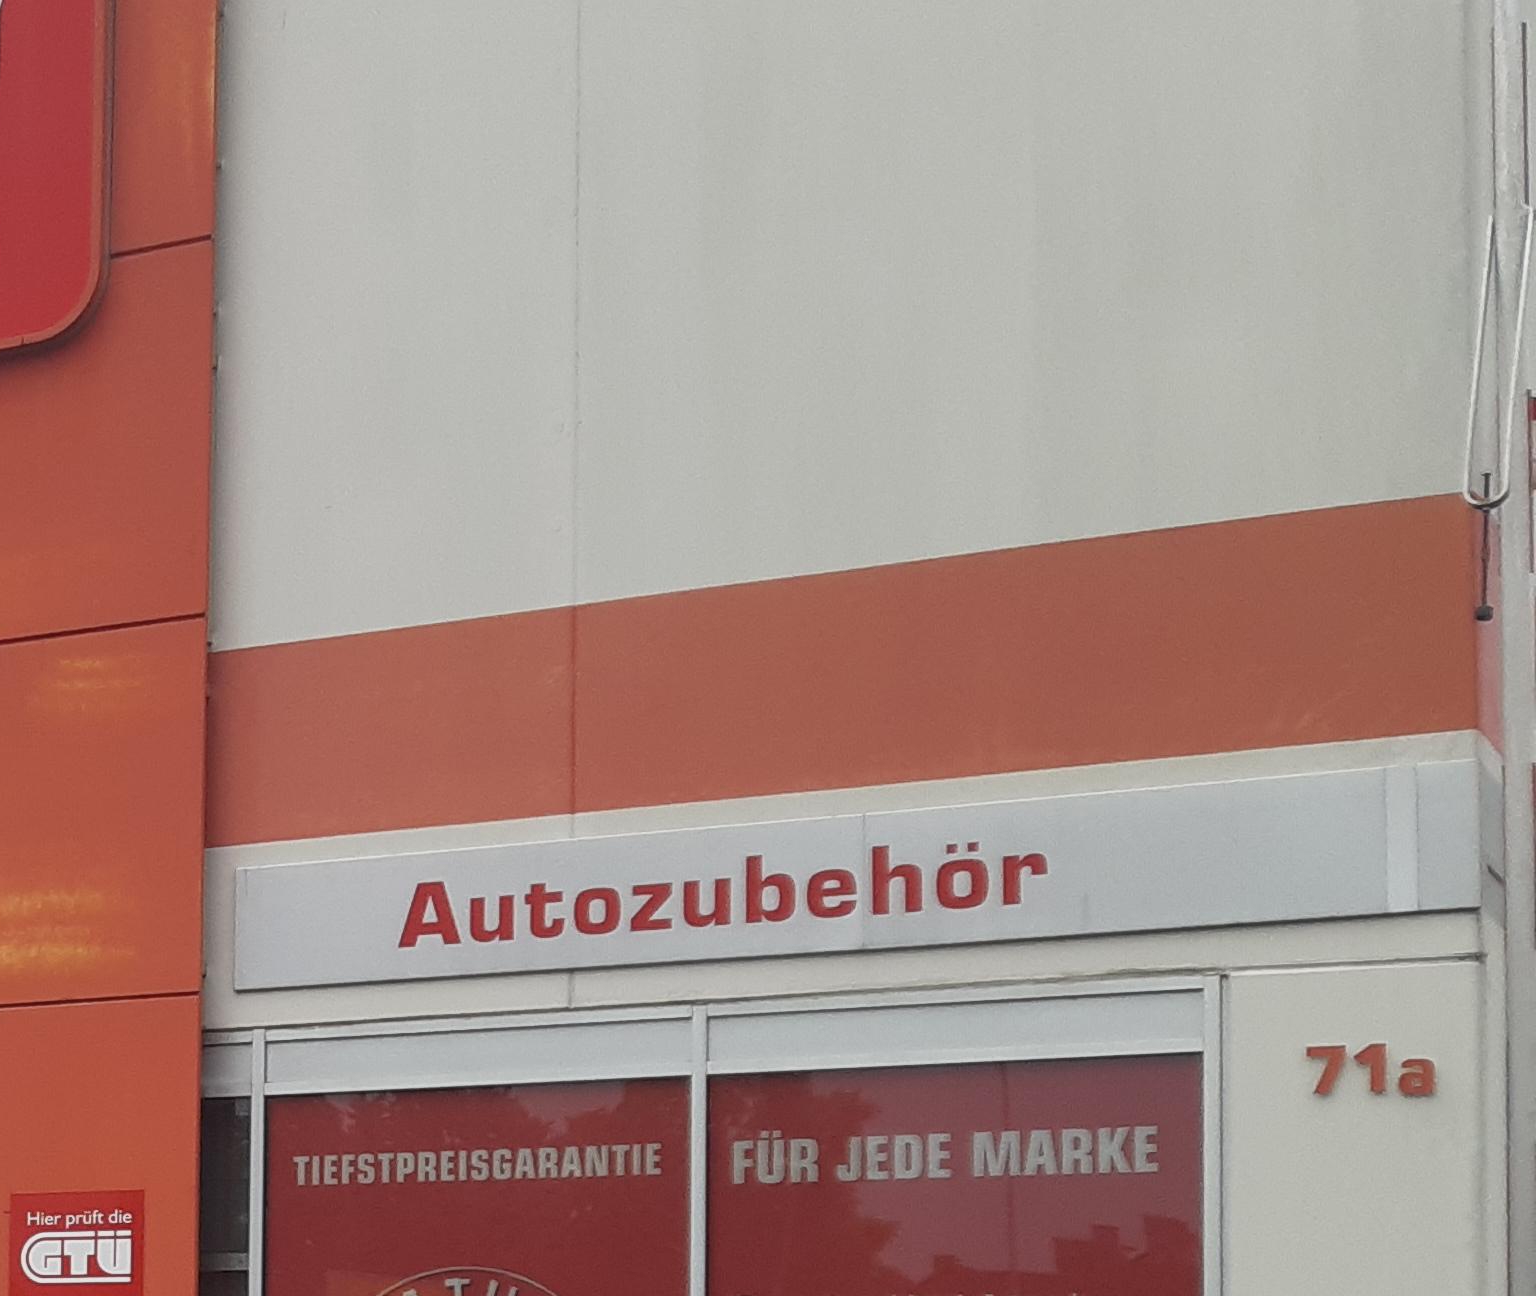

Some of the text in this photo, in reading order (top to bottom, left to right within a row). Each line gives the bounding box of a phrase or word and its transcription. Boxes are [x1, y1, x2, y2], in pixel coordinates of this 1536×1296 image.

[398, 841, 1050, 949] Autozubehör
[1306, 1043, 1437, 1098] 71a
[292, 1142, 663, 1186] TIEFSTPREISGARANTIE
[732, 1126, 1159, 1184] FÜR JEDE MARKE
[27, 1210, 132, 1229] Hier prüft die
[29, 1230, 132, 1276] GTÜ
